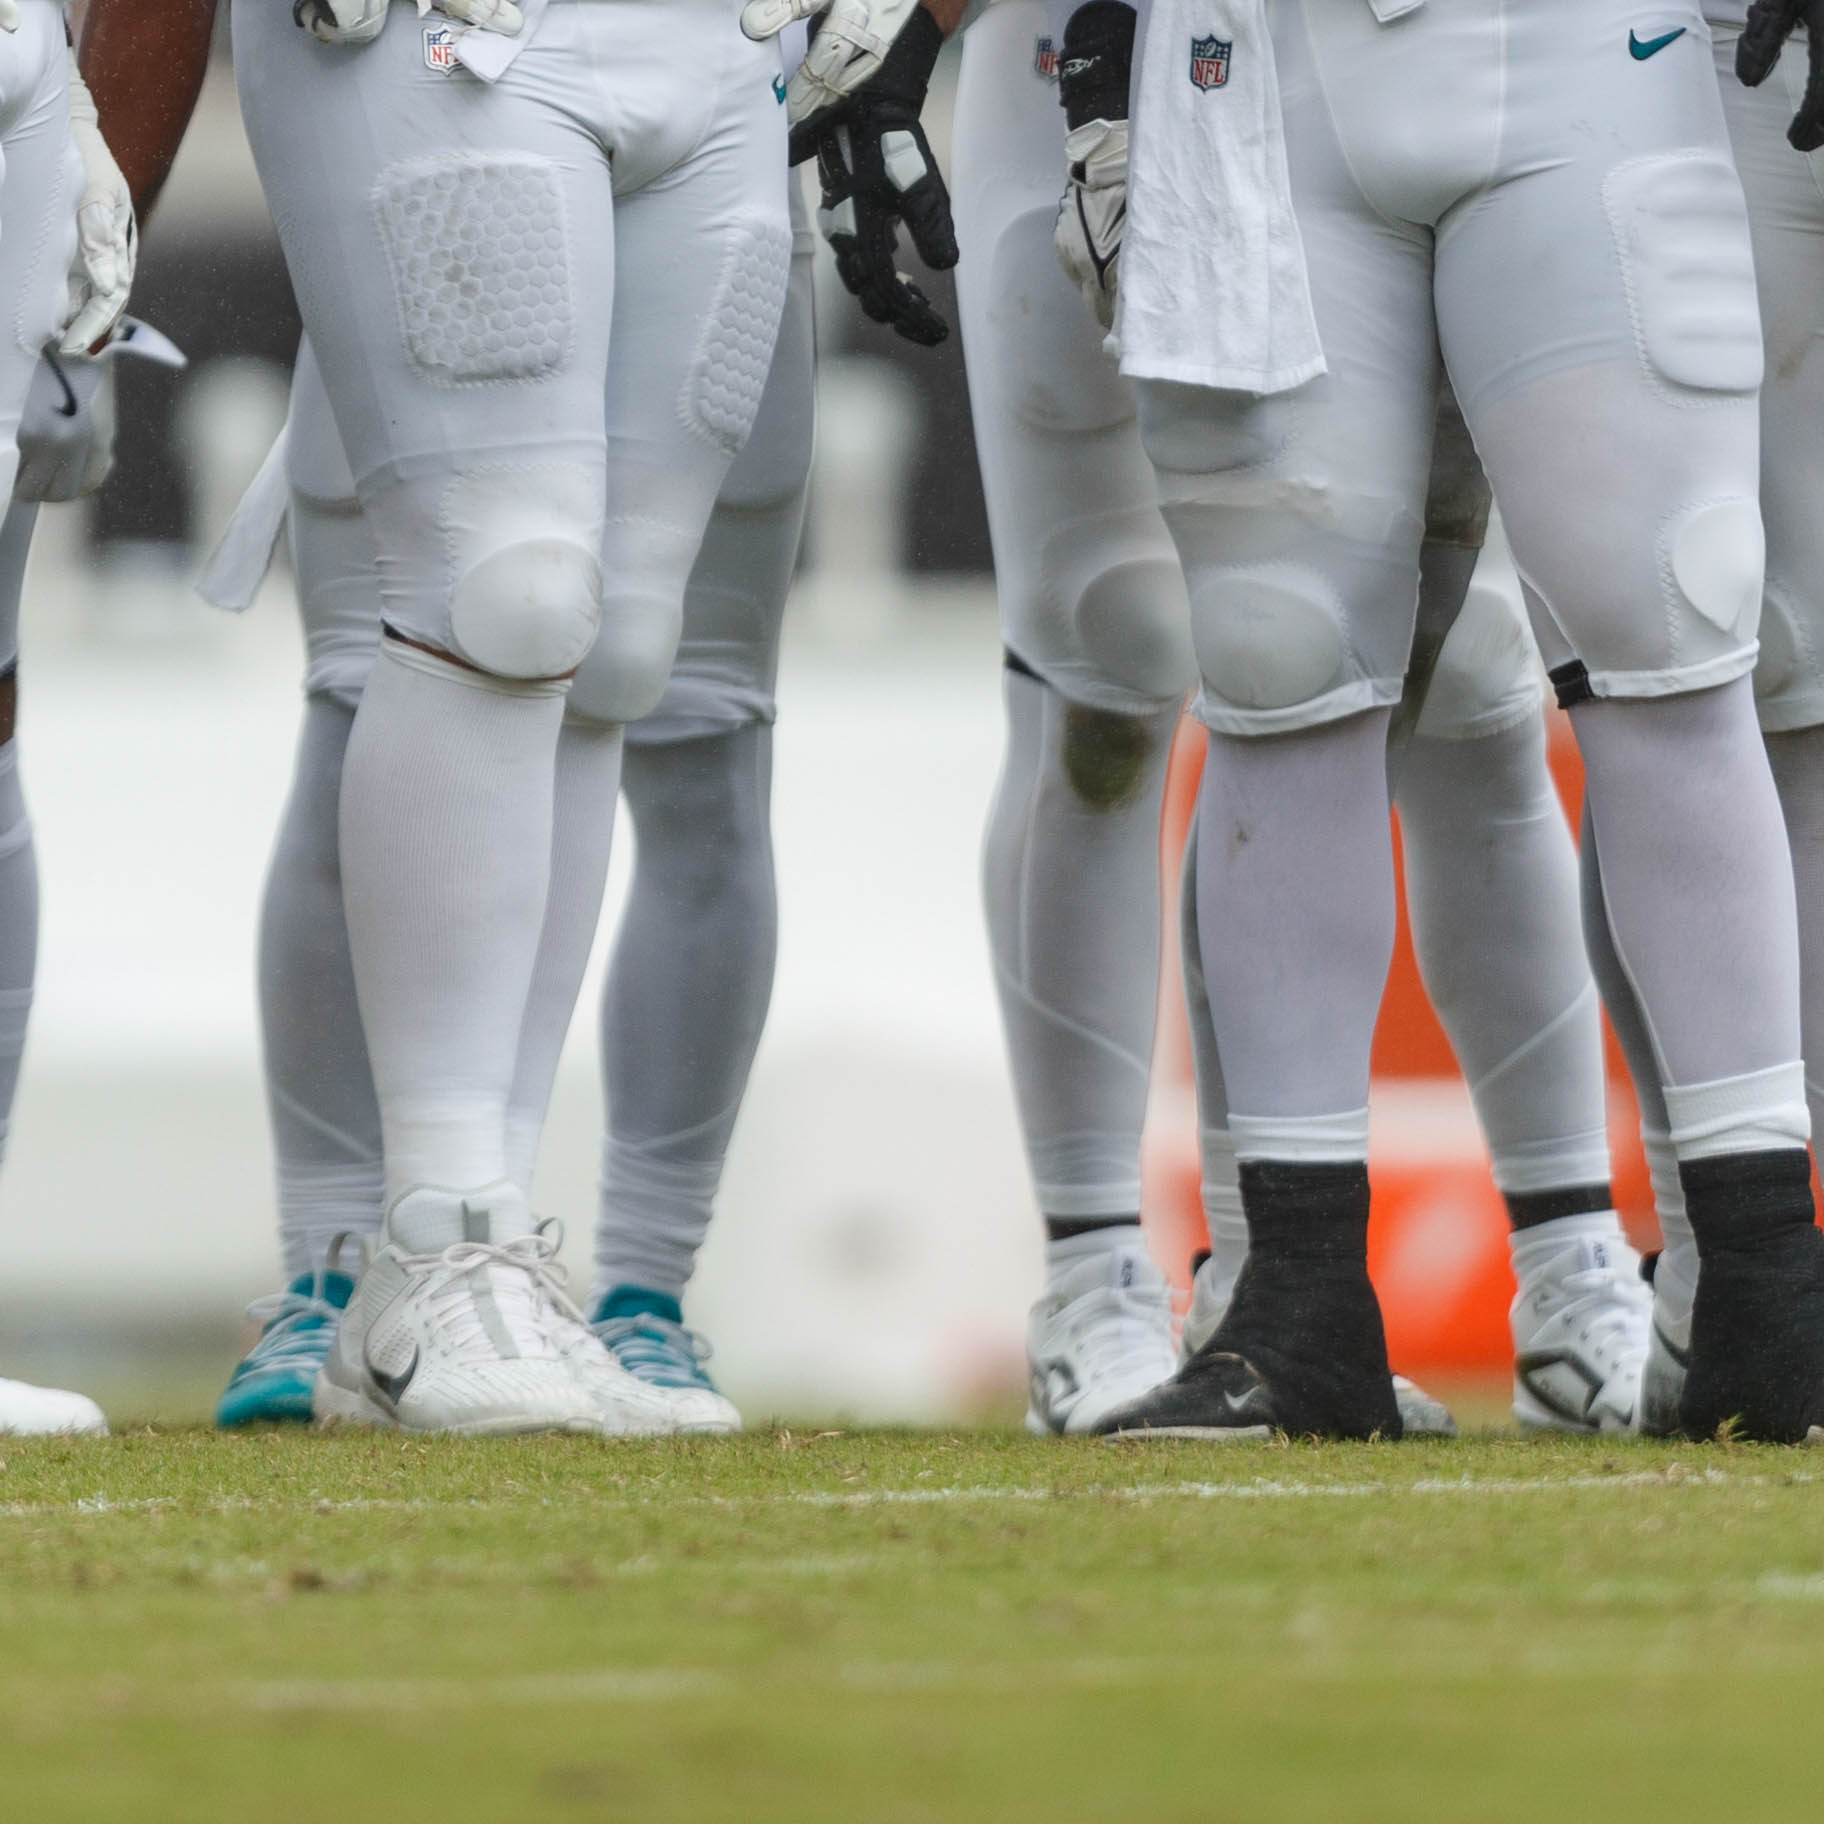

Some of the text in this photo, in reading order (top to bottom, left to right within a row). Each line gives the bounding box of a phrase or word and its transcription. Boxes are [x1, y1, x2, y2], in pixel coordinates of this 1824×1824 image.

[431, 45, 460, 66] NF
[1038, 52, 1062, 76] NF
[1193, 57, 1226, 86] NFL
